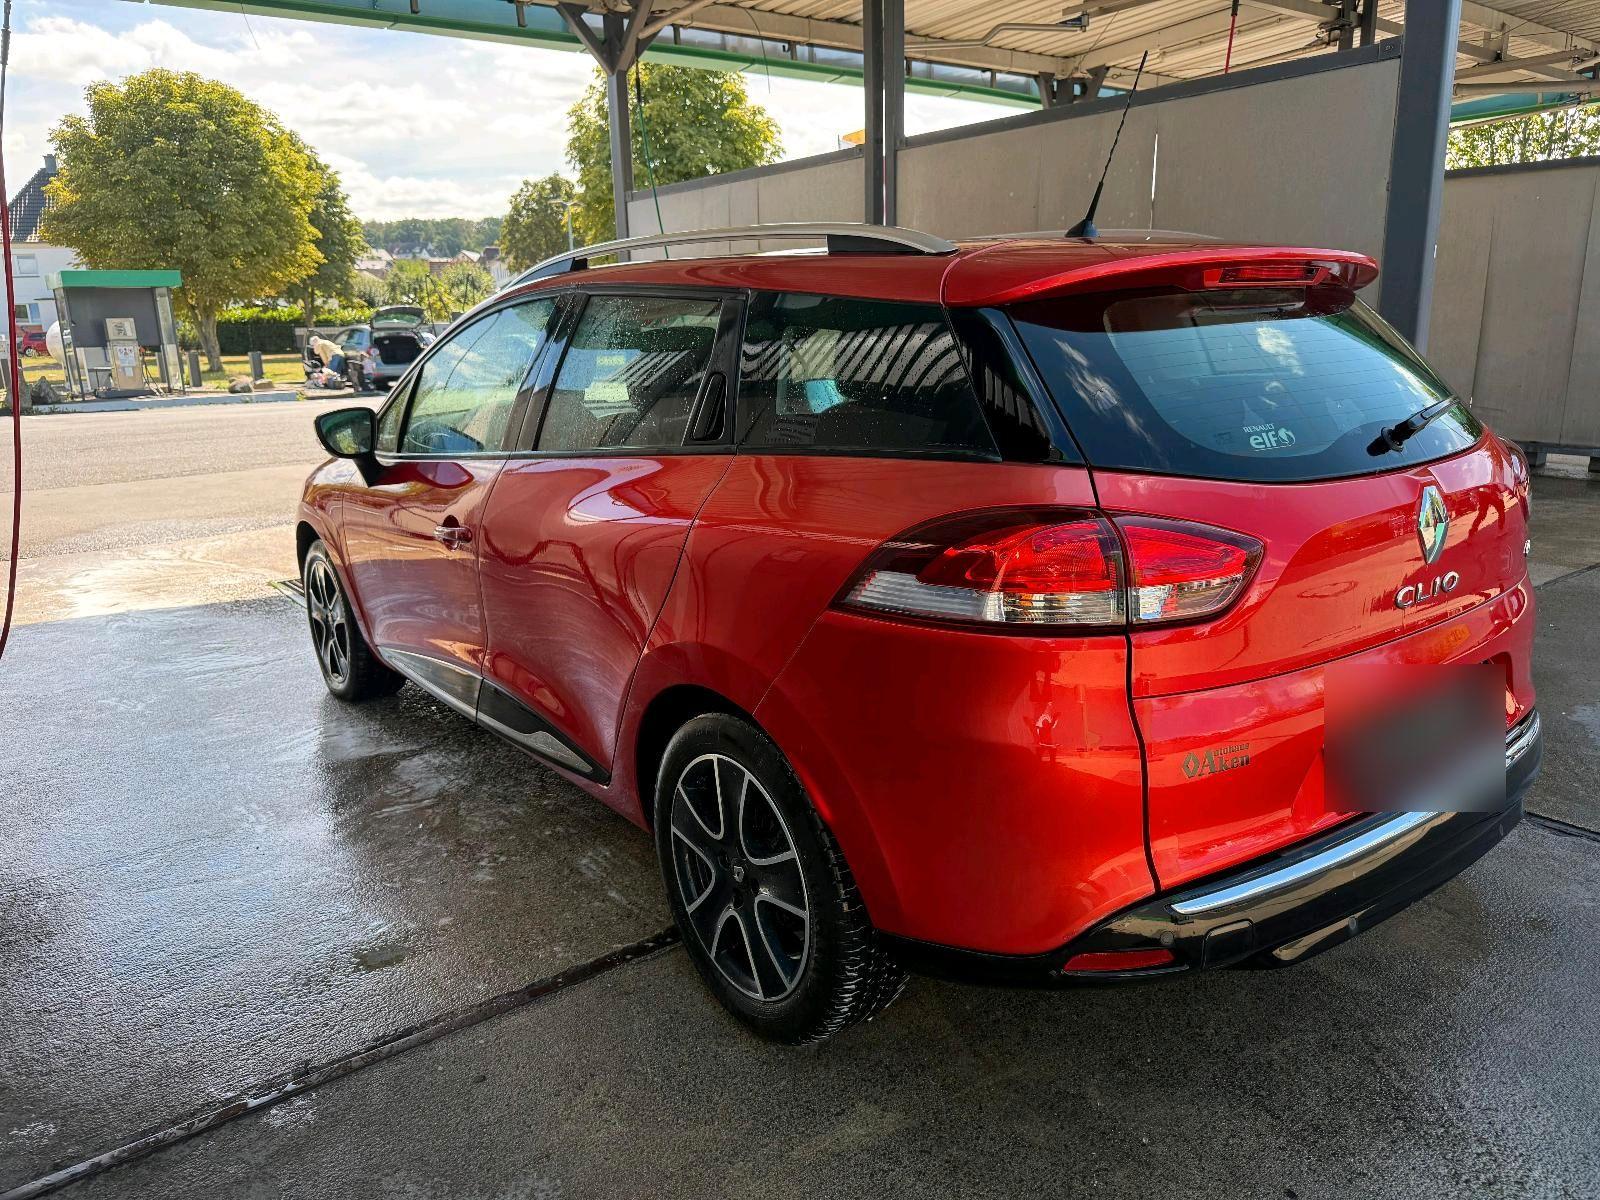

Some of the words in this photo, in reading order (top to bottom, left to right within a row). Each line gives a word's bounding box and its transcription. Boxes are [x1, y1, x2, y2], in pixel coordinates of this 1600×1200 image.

[1243, 423, 1275, 433] RENAULT
[1249, 431, 1278, 449] elf
[1395, 570, 1460, 609] CLIO
[1198, 749, 1250, 776] Aken
